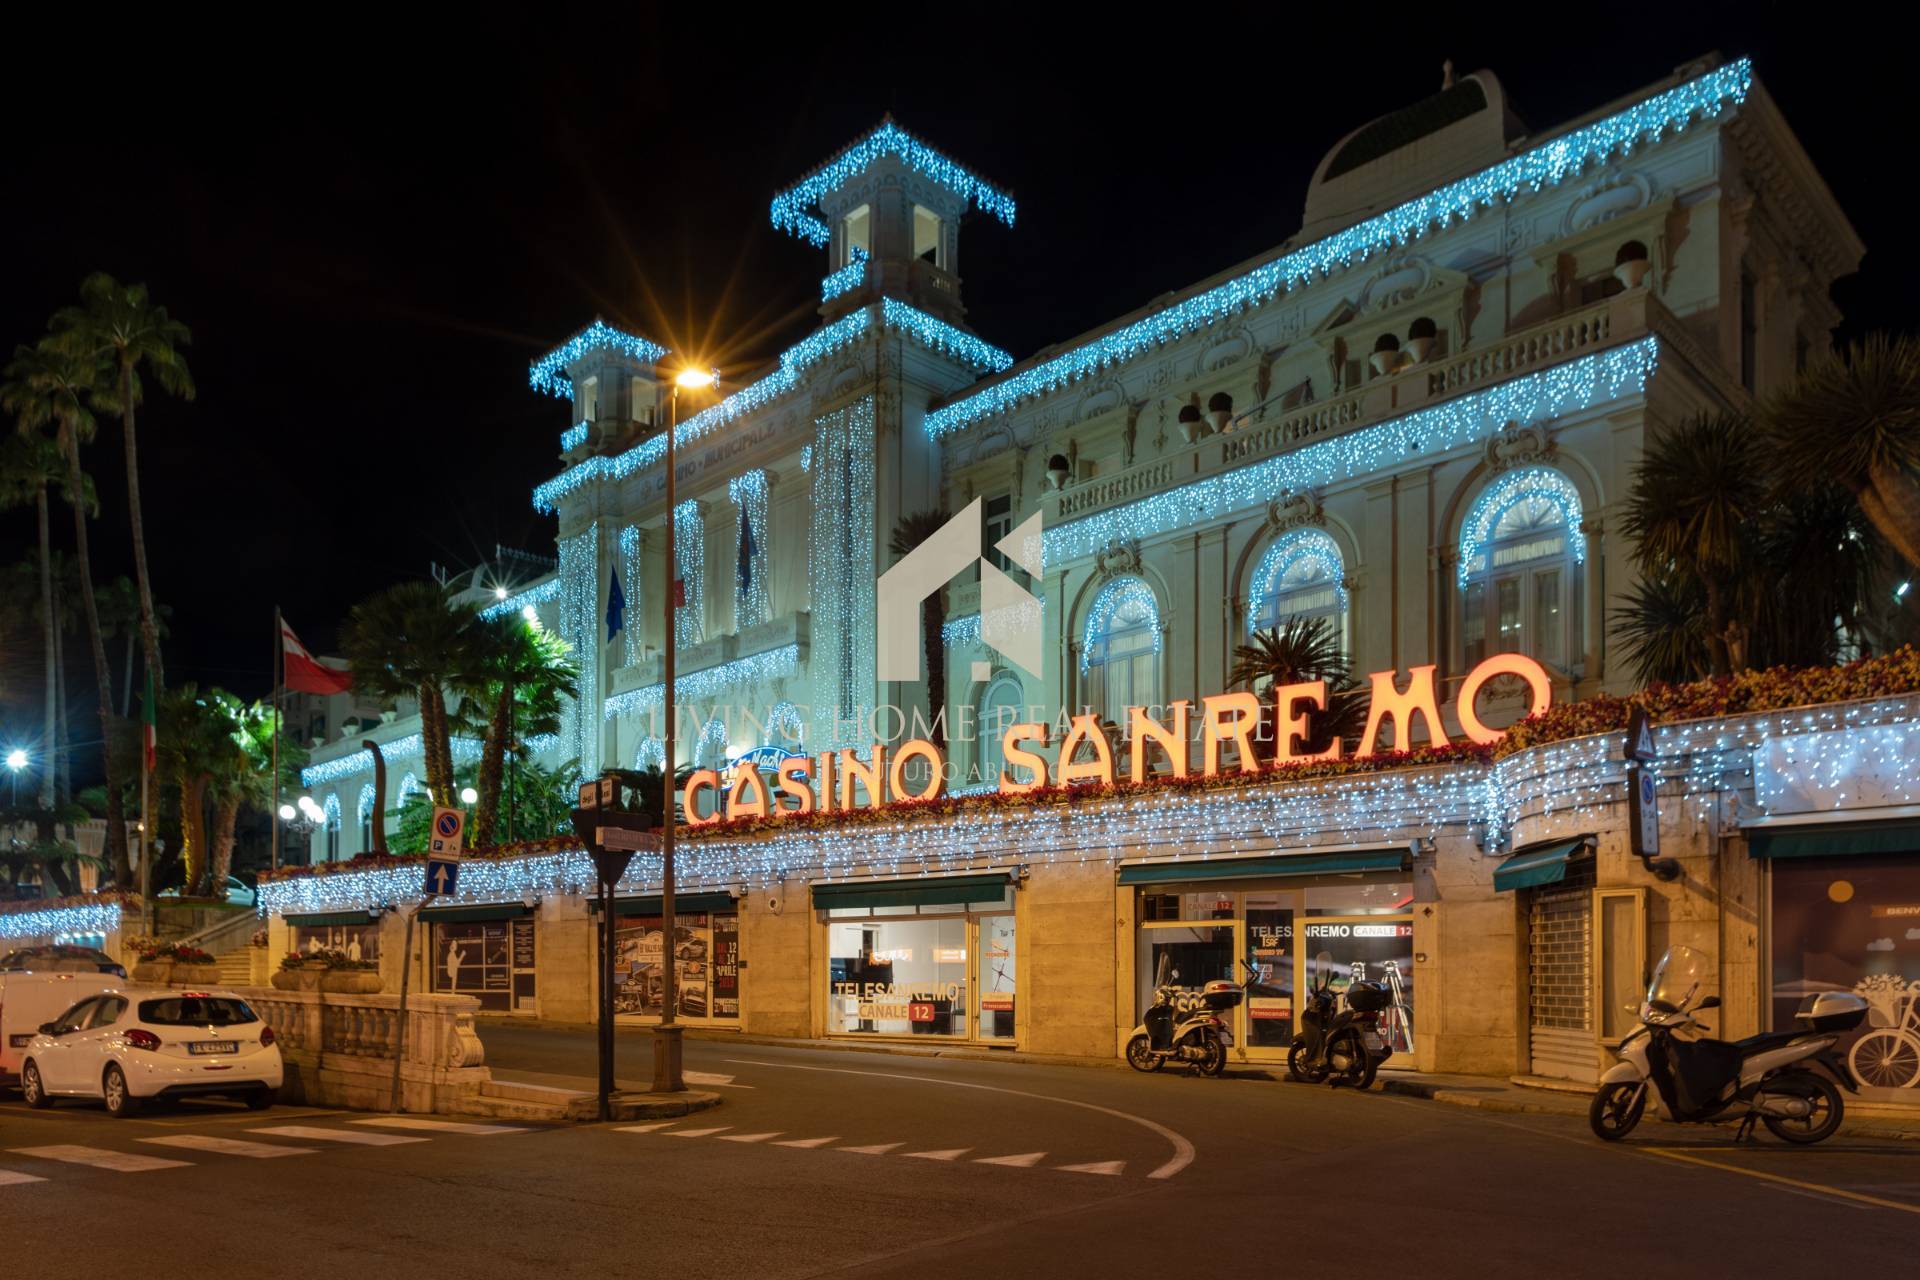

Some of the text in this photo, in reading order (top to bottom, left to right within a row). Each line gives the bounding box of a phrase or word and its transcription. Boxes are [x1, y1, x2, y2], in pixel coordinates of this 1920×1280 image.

[684, 739, 943, 826] CASINO
[1250, 925, 1412, 938] TELESNREMO CANALE 12
[728, 942, 737, 953] 12
[727, 954, 736, 965] 14
[858, 1004, 930, 1019] CANALE 12
[1250, 1009, 1290, 1018] Primocanale
